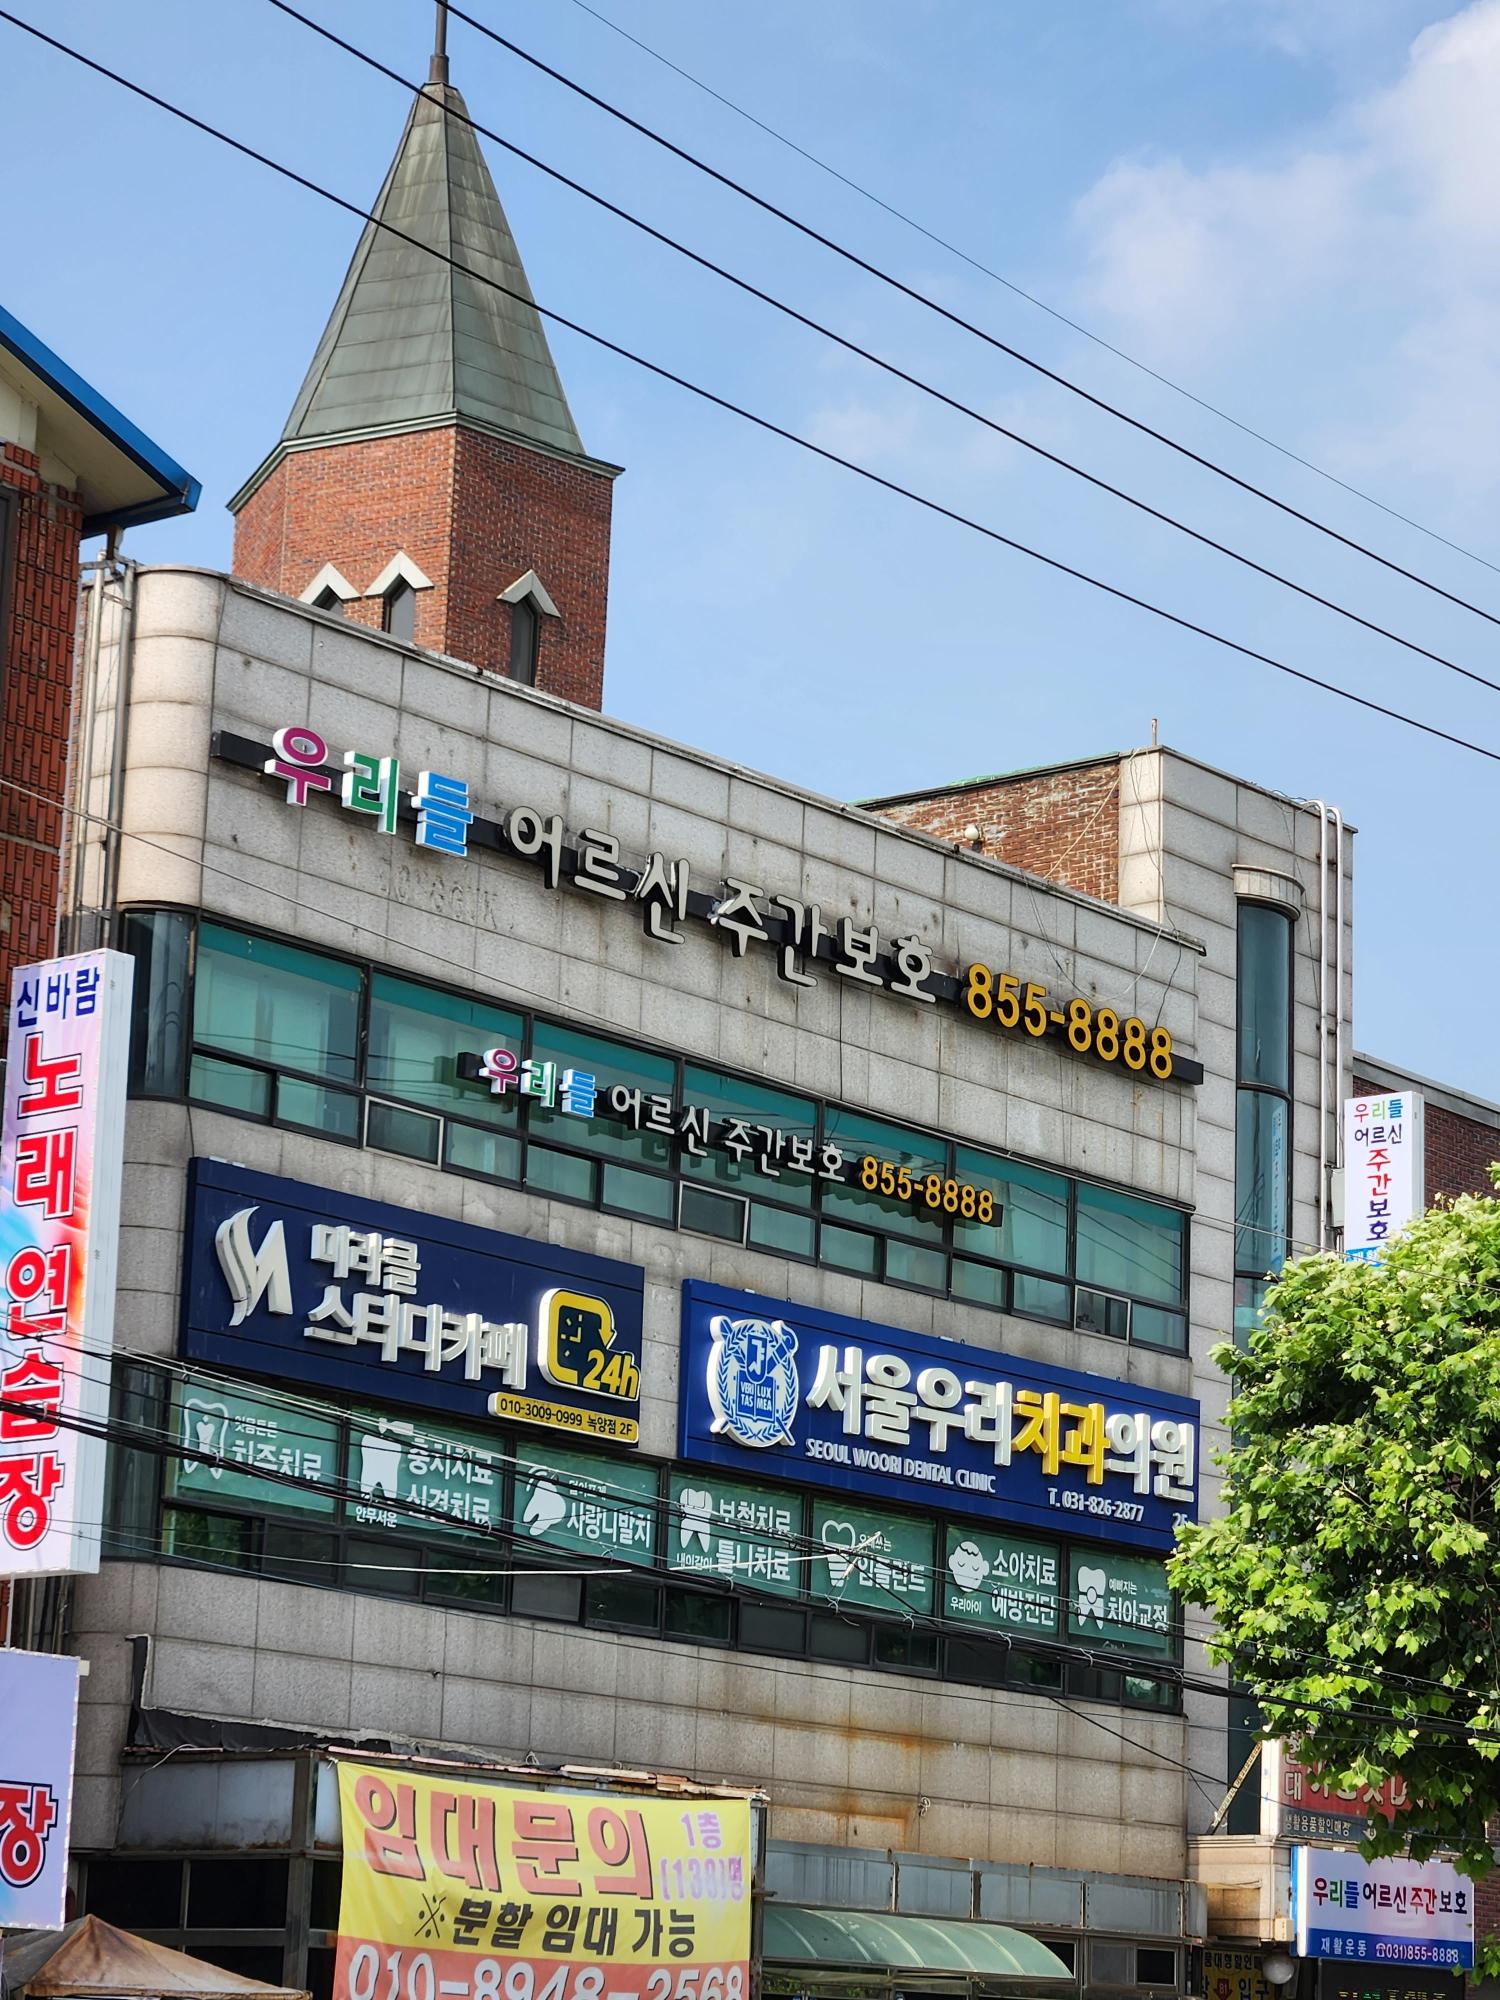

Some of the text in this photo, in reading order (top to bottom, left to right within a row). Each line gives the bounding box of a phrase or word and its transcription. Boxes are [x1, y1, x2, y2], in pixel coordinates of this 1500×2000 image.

[265, 727, 473, 857] 우리들
[503, 806, 690, 945] 어르신
[719, 877, 936, 1003] 주간보호
[967, 962, 1173, 1079] 855-8888
[16, 968, 100, 1028] 신바람
[1354, 1099, 1403, 1122] 우리들
[479, 1048, 993, 1222] 우리들 어르신 주간보호 855-8888
[1354, 1124, 1402, 1146] 어르신
[1366, 1149, 1392, 1241] 주간보호
[311, 1224, 421, 1294] 미라클
[304, 1285, 528, 1390] 스터디카페
[583, 1350, 638, 1399] 24h
[757, 1384, 771, 1399] LUX
[500, 1398, 632, 1436] 010-3009-0999 녹양점 2F
[757, 1398, 772, 1411] MEA
[408, 1437, 493, 1485] 충치치료
[805, 1438, 996, 1493] SEOUL WOORI DENTAL CLINIC
[356, 1505, 398, 1528] 안무서운
[1047, 1487, 1144, 1522] T. 031-826-2877
[566, 1502, 651, 1548] 사랑니발치
[716, 1540, 791, 1581] 틀니치료
[857, 1555, 926, 1592] 임플란트
[992, 1549, 1057, 1586] 소아치료
[950, 1596, 982, 1616] 우리아이
[991, 1587, 1057, 1626] 예방진단
[1107, 1596, 1168, 1633] 치아교정
[680, 1812, 722, 1849] 1층
[452, 1898, 695, 1957] 분할 임대 가능
